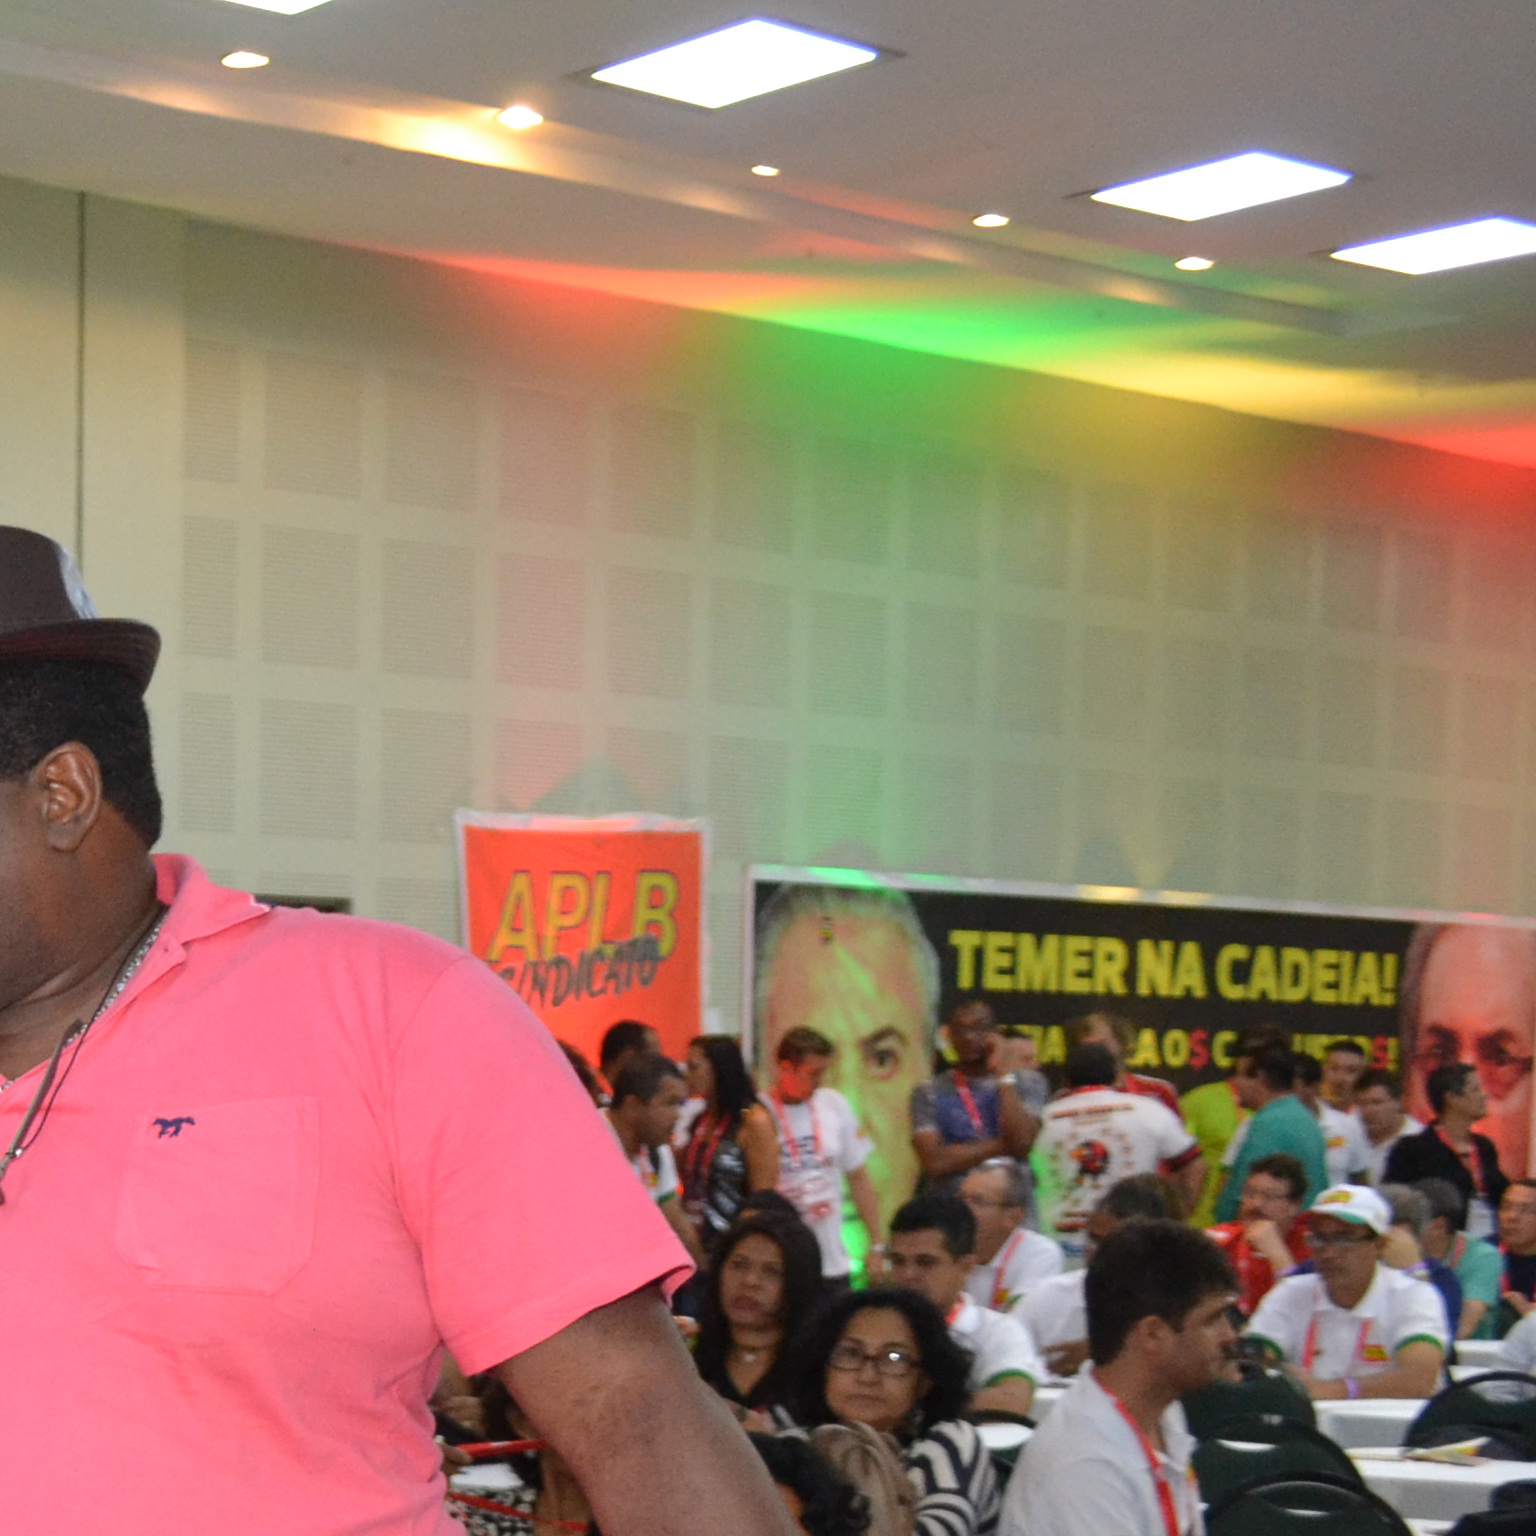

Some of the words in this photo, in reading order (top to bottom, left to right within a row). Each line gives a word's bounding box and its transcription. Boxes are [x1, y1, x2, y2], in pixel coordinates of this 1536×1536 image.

[948, 929, 1129, 996] TEMER
[1136, 938, 1208, 999] NA
[1215, 943, 1399, 1007] CADEIA!
